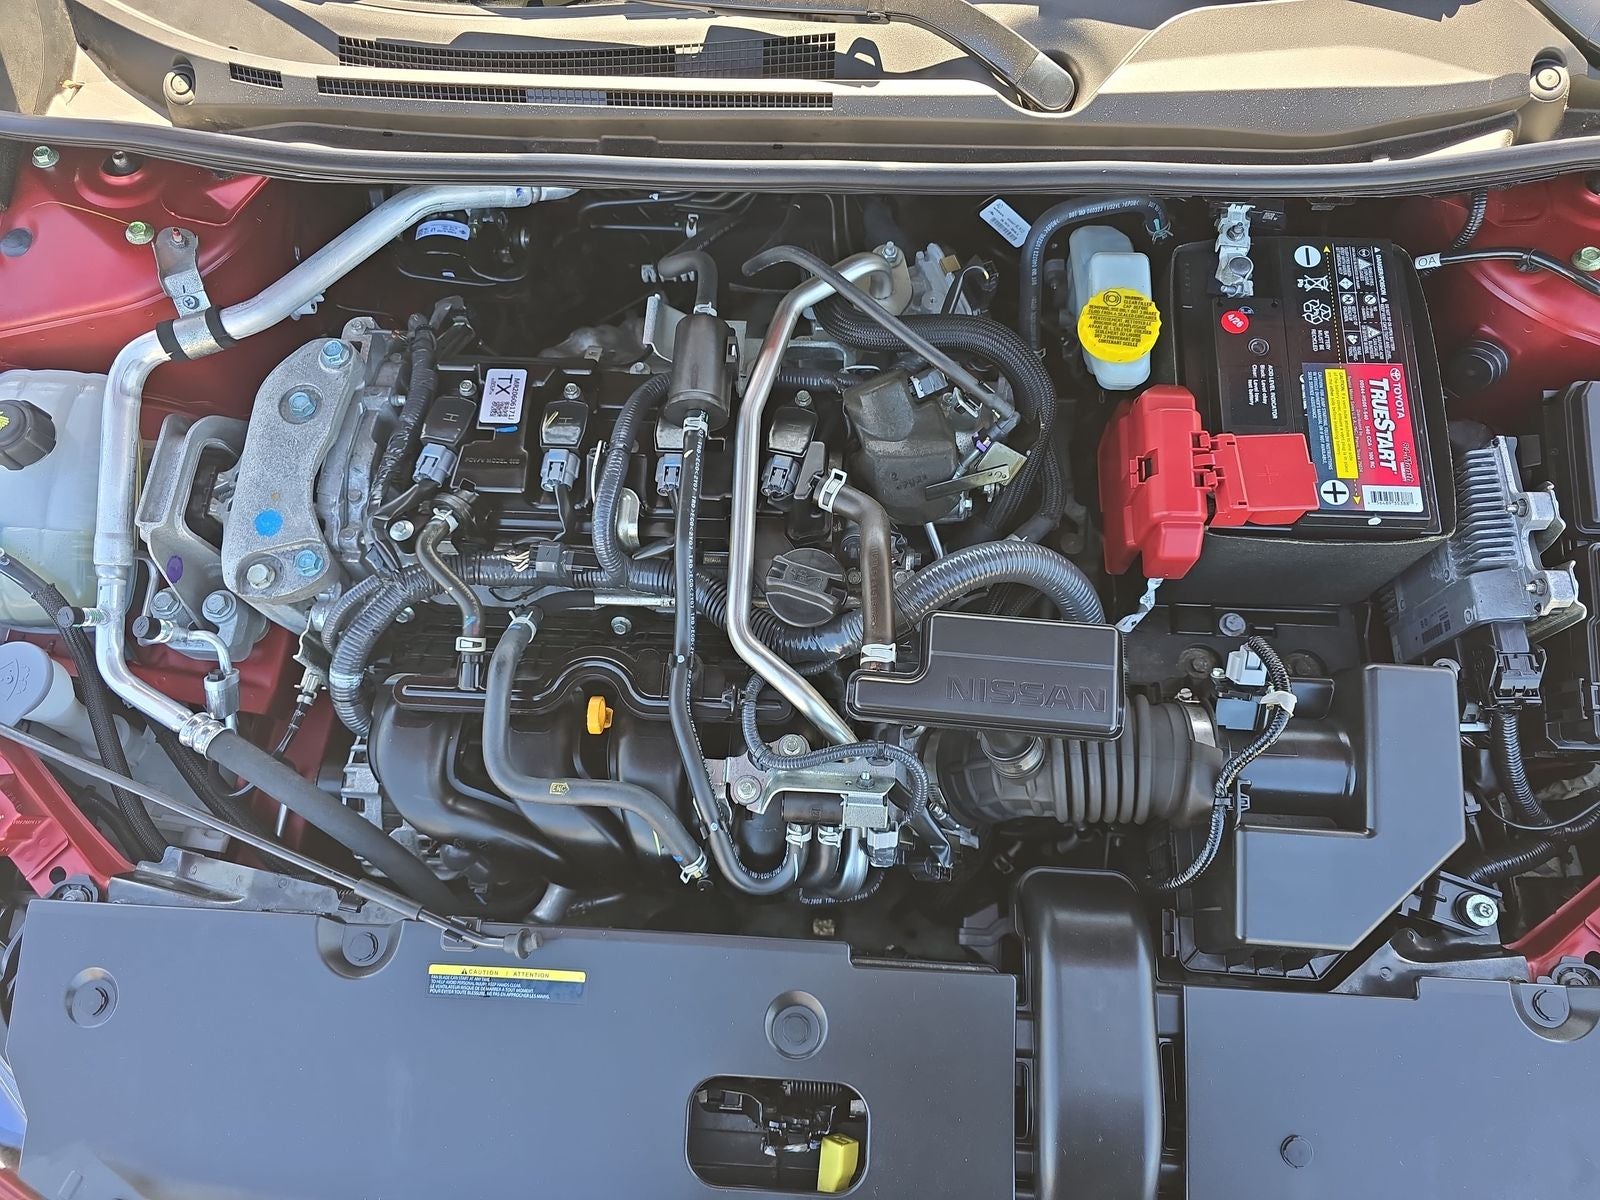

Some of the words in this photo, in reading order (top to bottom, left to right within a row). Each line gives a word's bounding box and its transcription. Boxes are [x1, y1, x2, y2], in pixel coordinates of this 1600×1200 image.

[1418, 256, 1436, 266] OA
[1228, 314, 1244, 328] 4/26
[496, 374, 513, 394] TX
[1392, 382, 1404, 418] TOYOTA
[946, 676, 1108, 712] NISSAN
